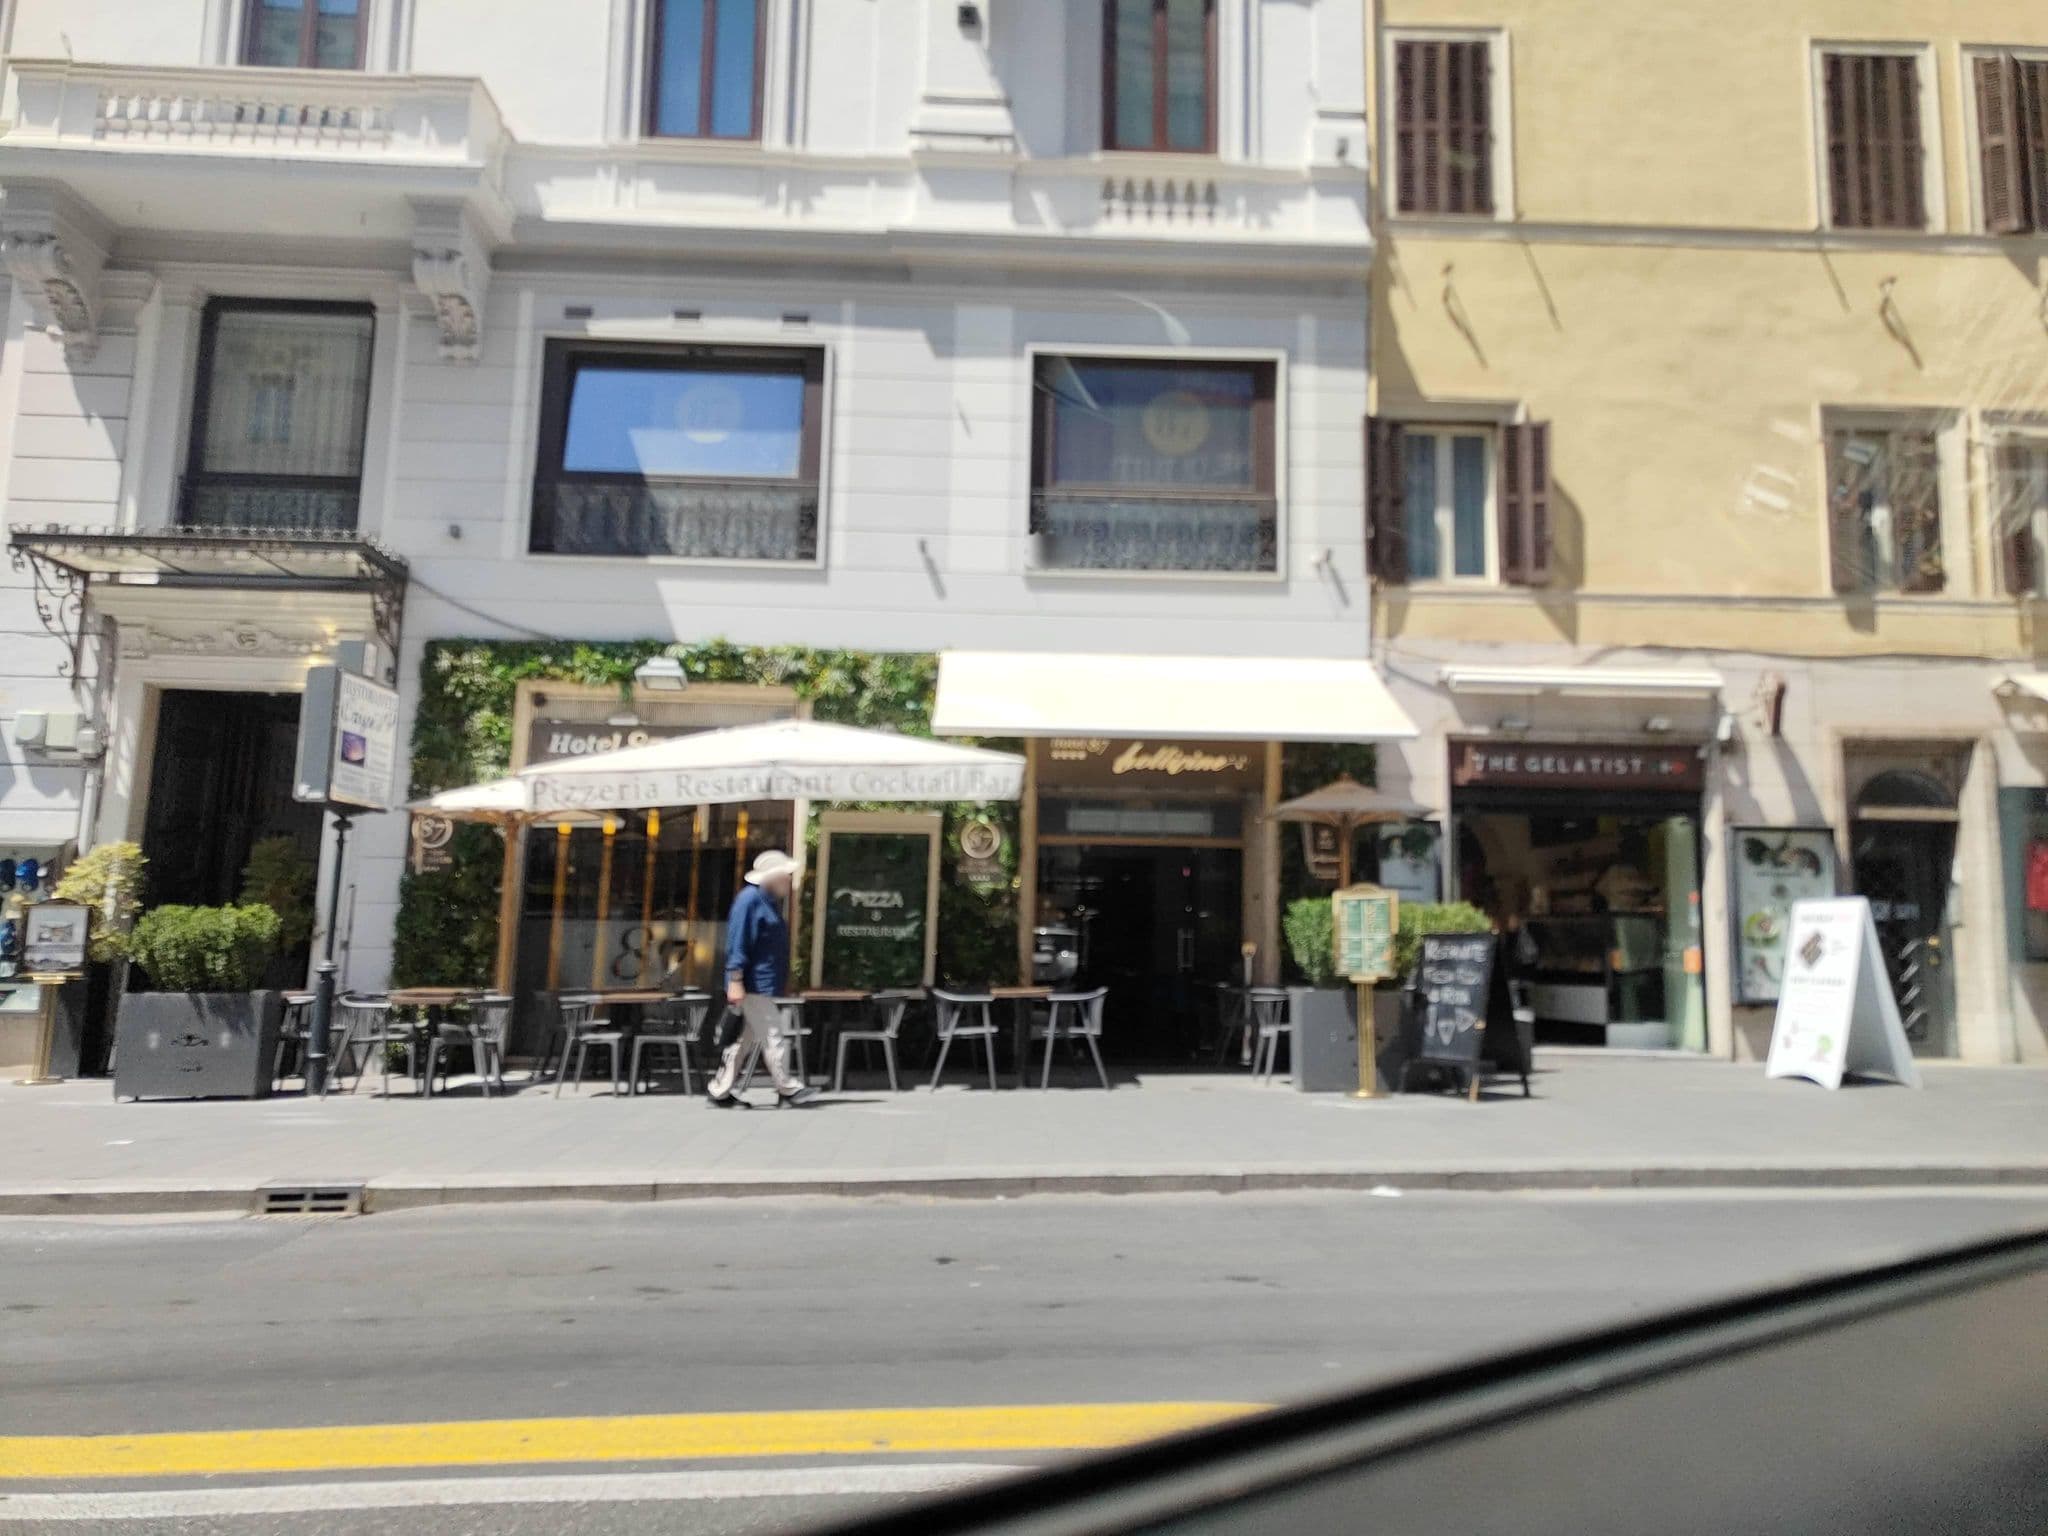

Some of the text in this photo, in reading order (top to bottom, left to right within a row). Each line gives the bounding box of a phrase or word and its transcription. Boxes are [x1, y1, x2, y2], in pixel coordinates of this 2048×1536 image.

[547, 733, 622, 754] Hotel
[1472, 752, 1642, 776] THE GELATIST
[531, 768, 1016, 806] Pizzeria Restaurant Cocktail Bar
[836, 889, 905, 909] PIZZA
